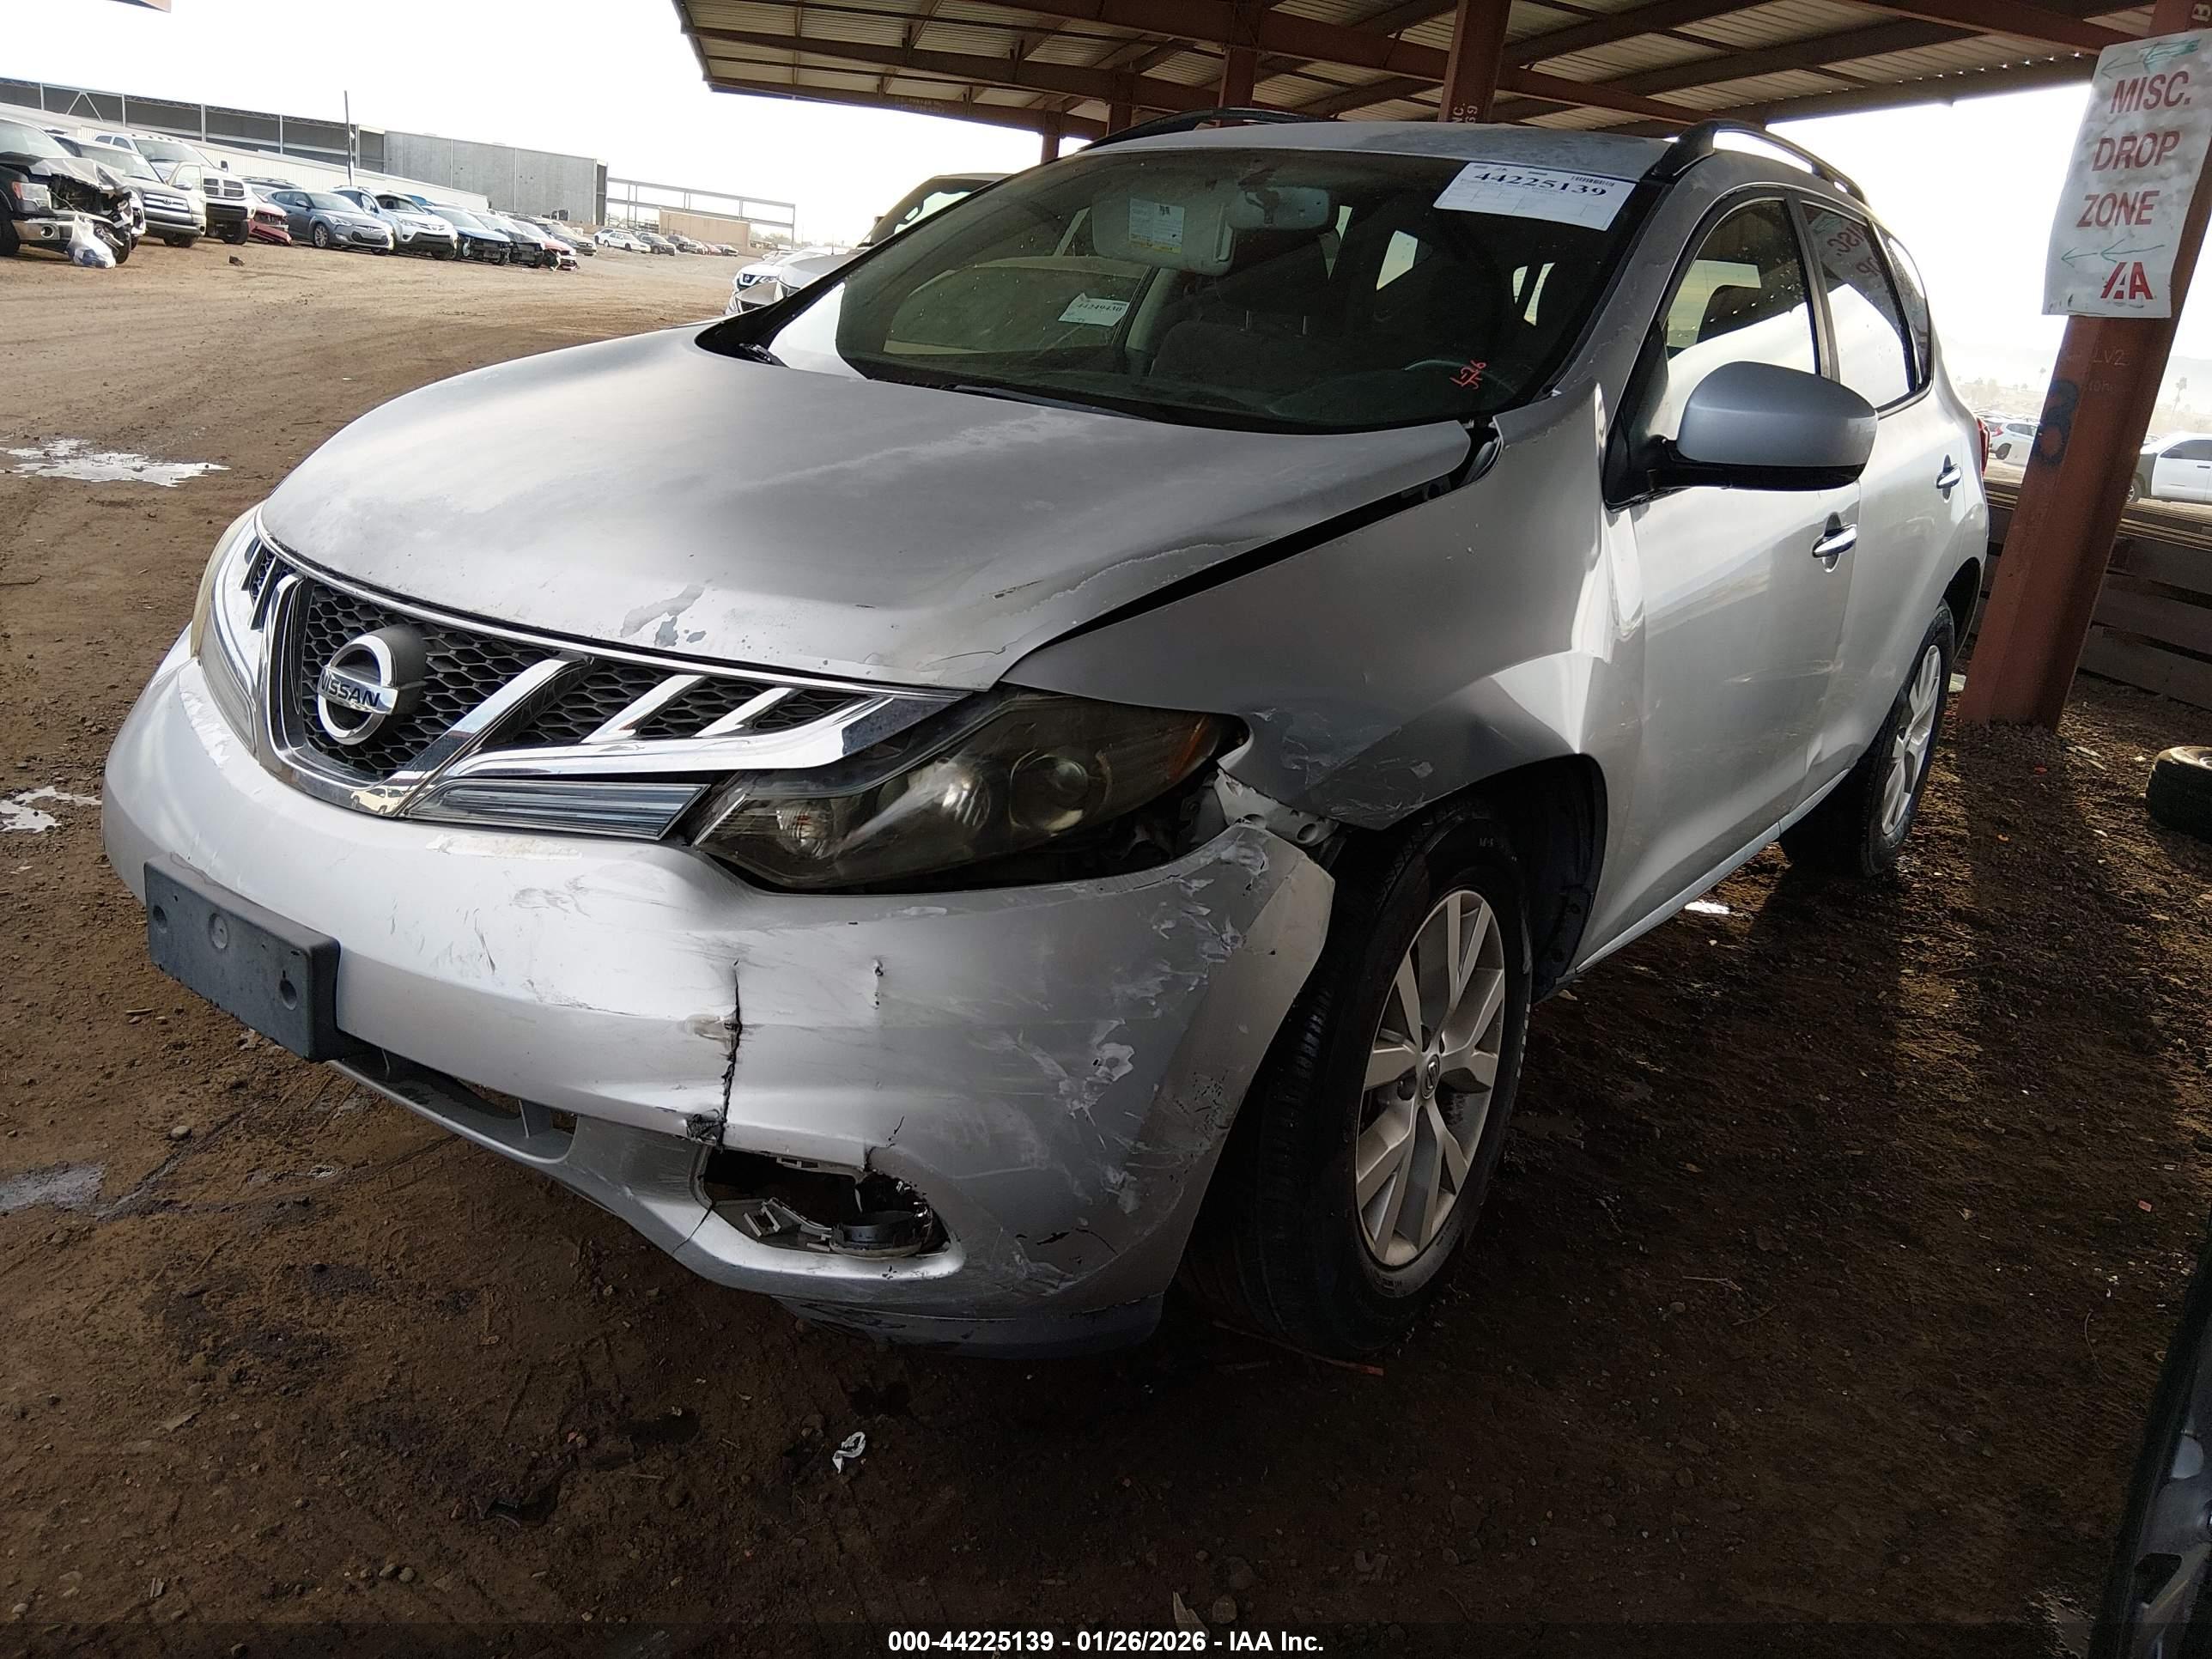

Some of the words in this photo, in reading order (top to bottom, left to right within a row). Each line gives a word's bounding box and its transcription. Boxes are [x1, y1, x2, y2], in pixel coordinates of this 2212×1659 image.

[2109, 70, 2191, 114] MISC.
[2092, 131, 2180, 172] DROP
[1474, 173, 1607, 196] 44225139
[2076, 190, 2160, 228] ZONE
[319, 673, 380, 708] NISSAN
